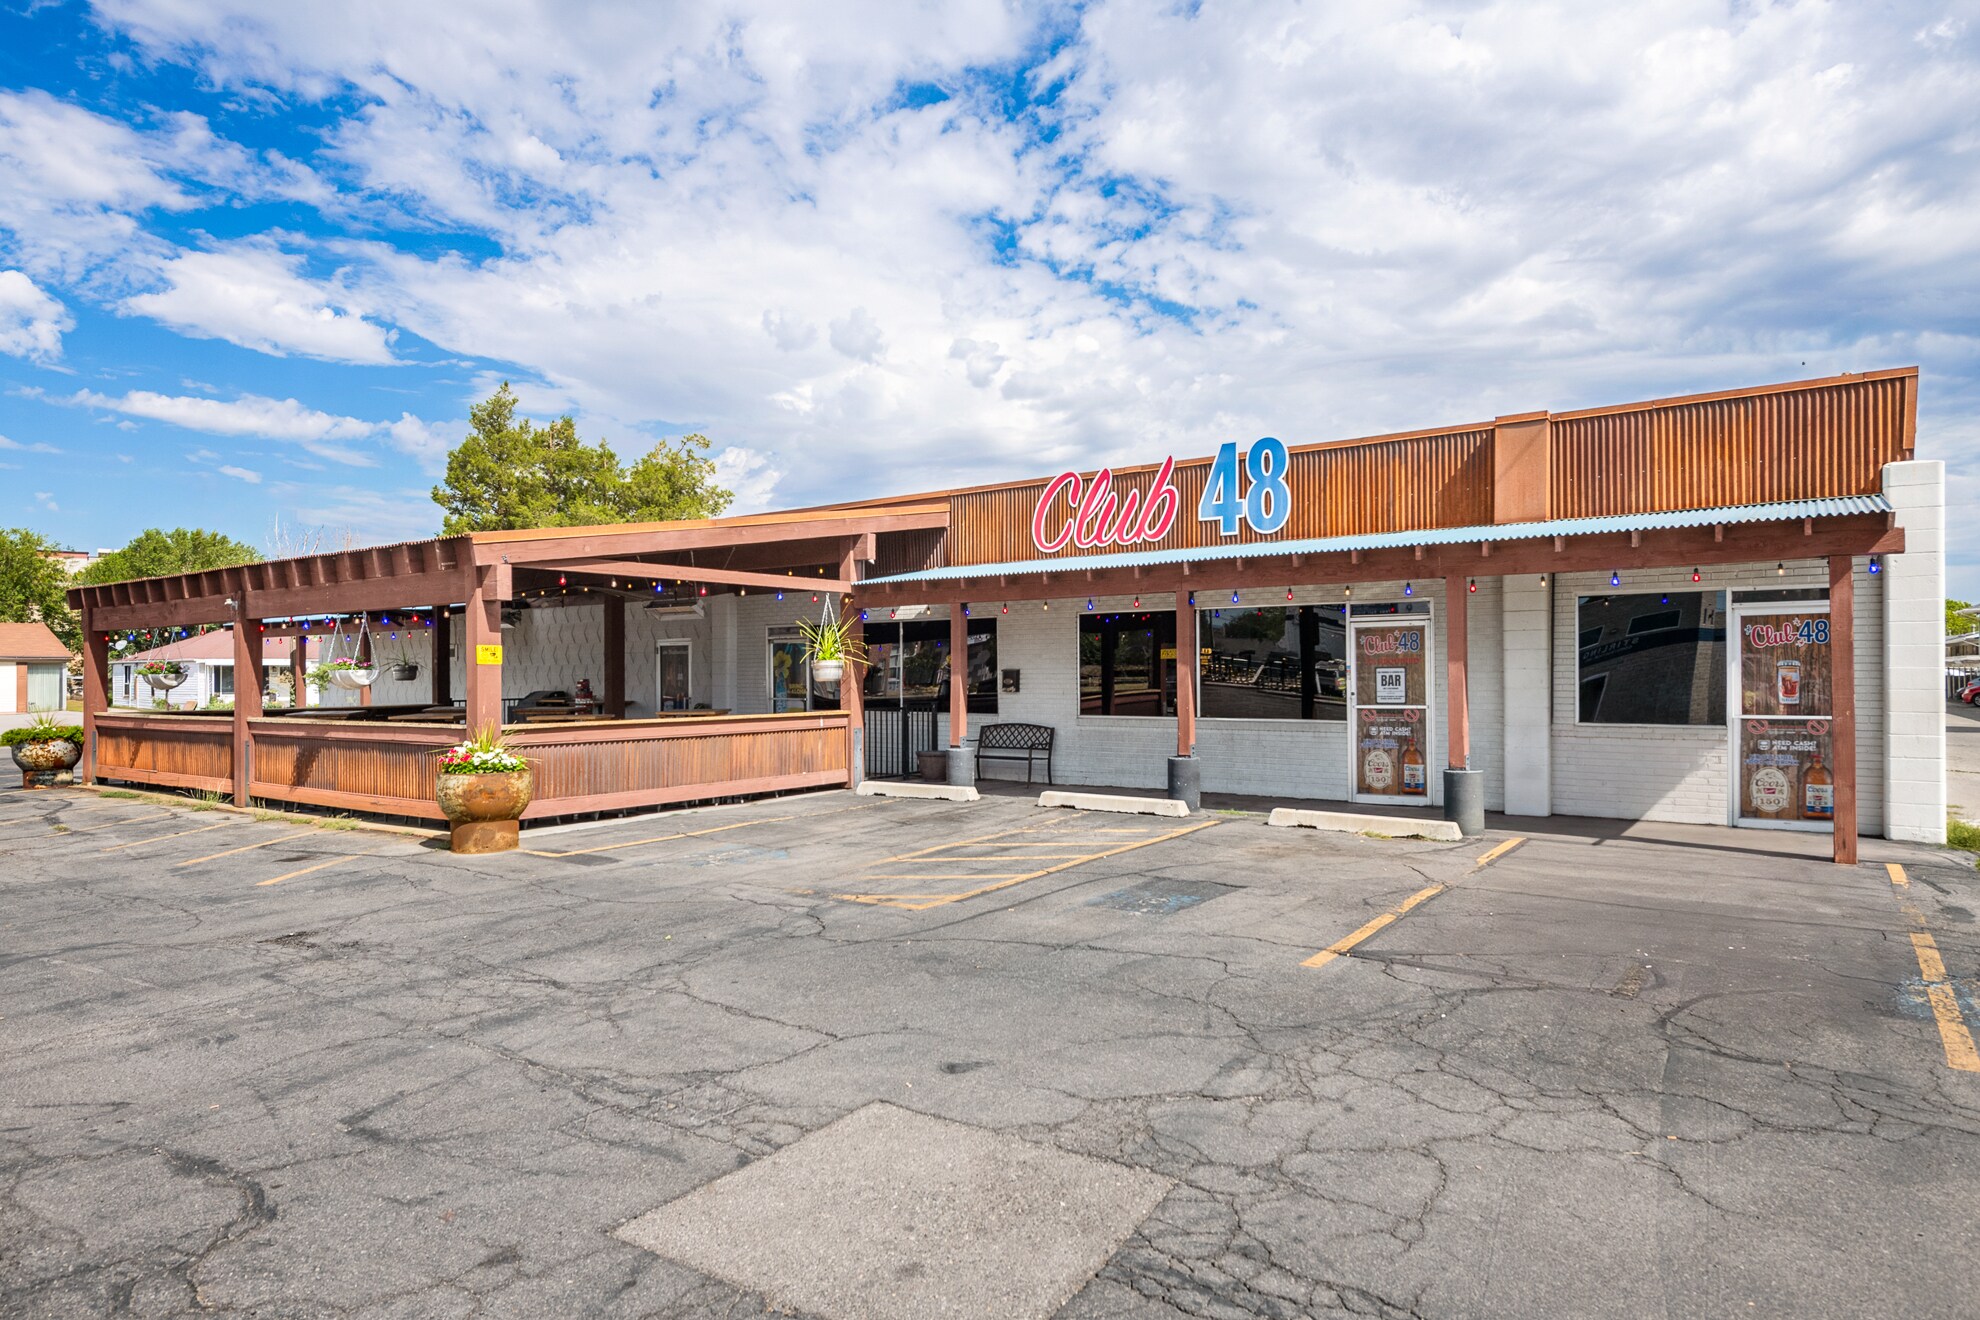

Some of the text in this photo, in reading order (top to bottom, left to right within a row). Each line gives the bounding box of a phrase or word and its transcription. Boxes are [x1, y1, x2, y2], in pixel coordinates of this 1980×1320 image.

[1032, 436, 1291, 553] Club 48
[1750, 619, 1830, 648] Club 48
[1364, 631, 1420, 655] Club 48
[1381, 674, 1401, 686] BAR
[1368, 759, 1389, 767] Coors
[1755, 778, 1785, 787] Coors
